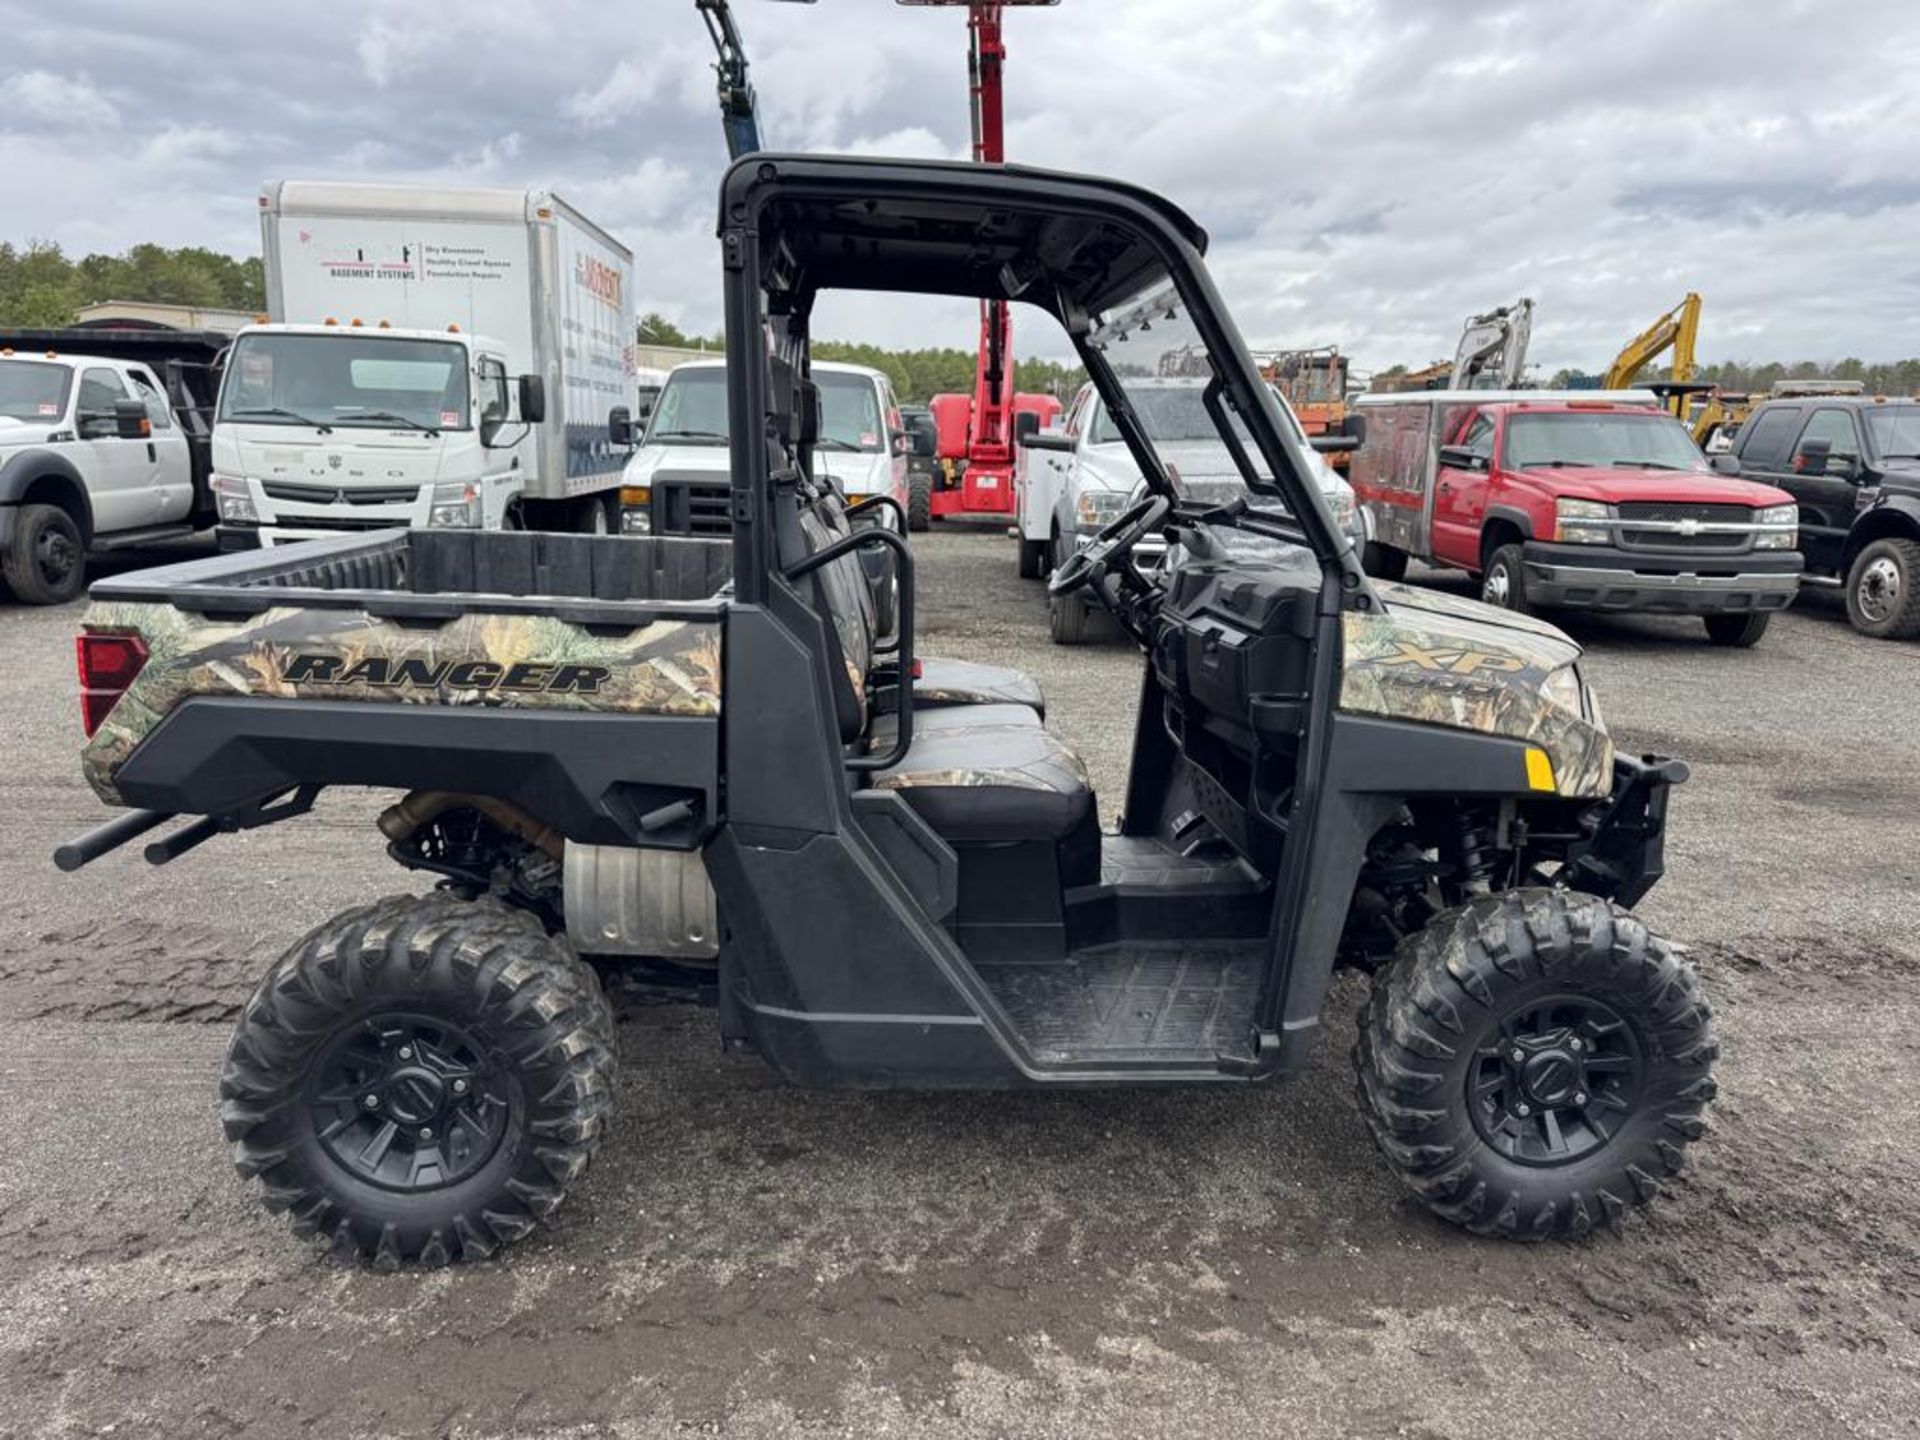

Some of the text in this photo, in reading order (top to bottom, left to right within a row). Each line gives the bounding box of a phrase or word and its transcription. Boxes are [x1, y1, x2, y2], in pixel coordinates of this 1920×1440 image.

[330, 268, 415, 281] BASEMENT SYSTEMS
[281, 654, 613, 695] RANGER
[1372, 640, 1529, 675] XP
